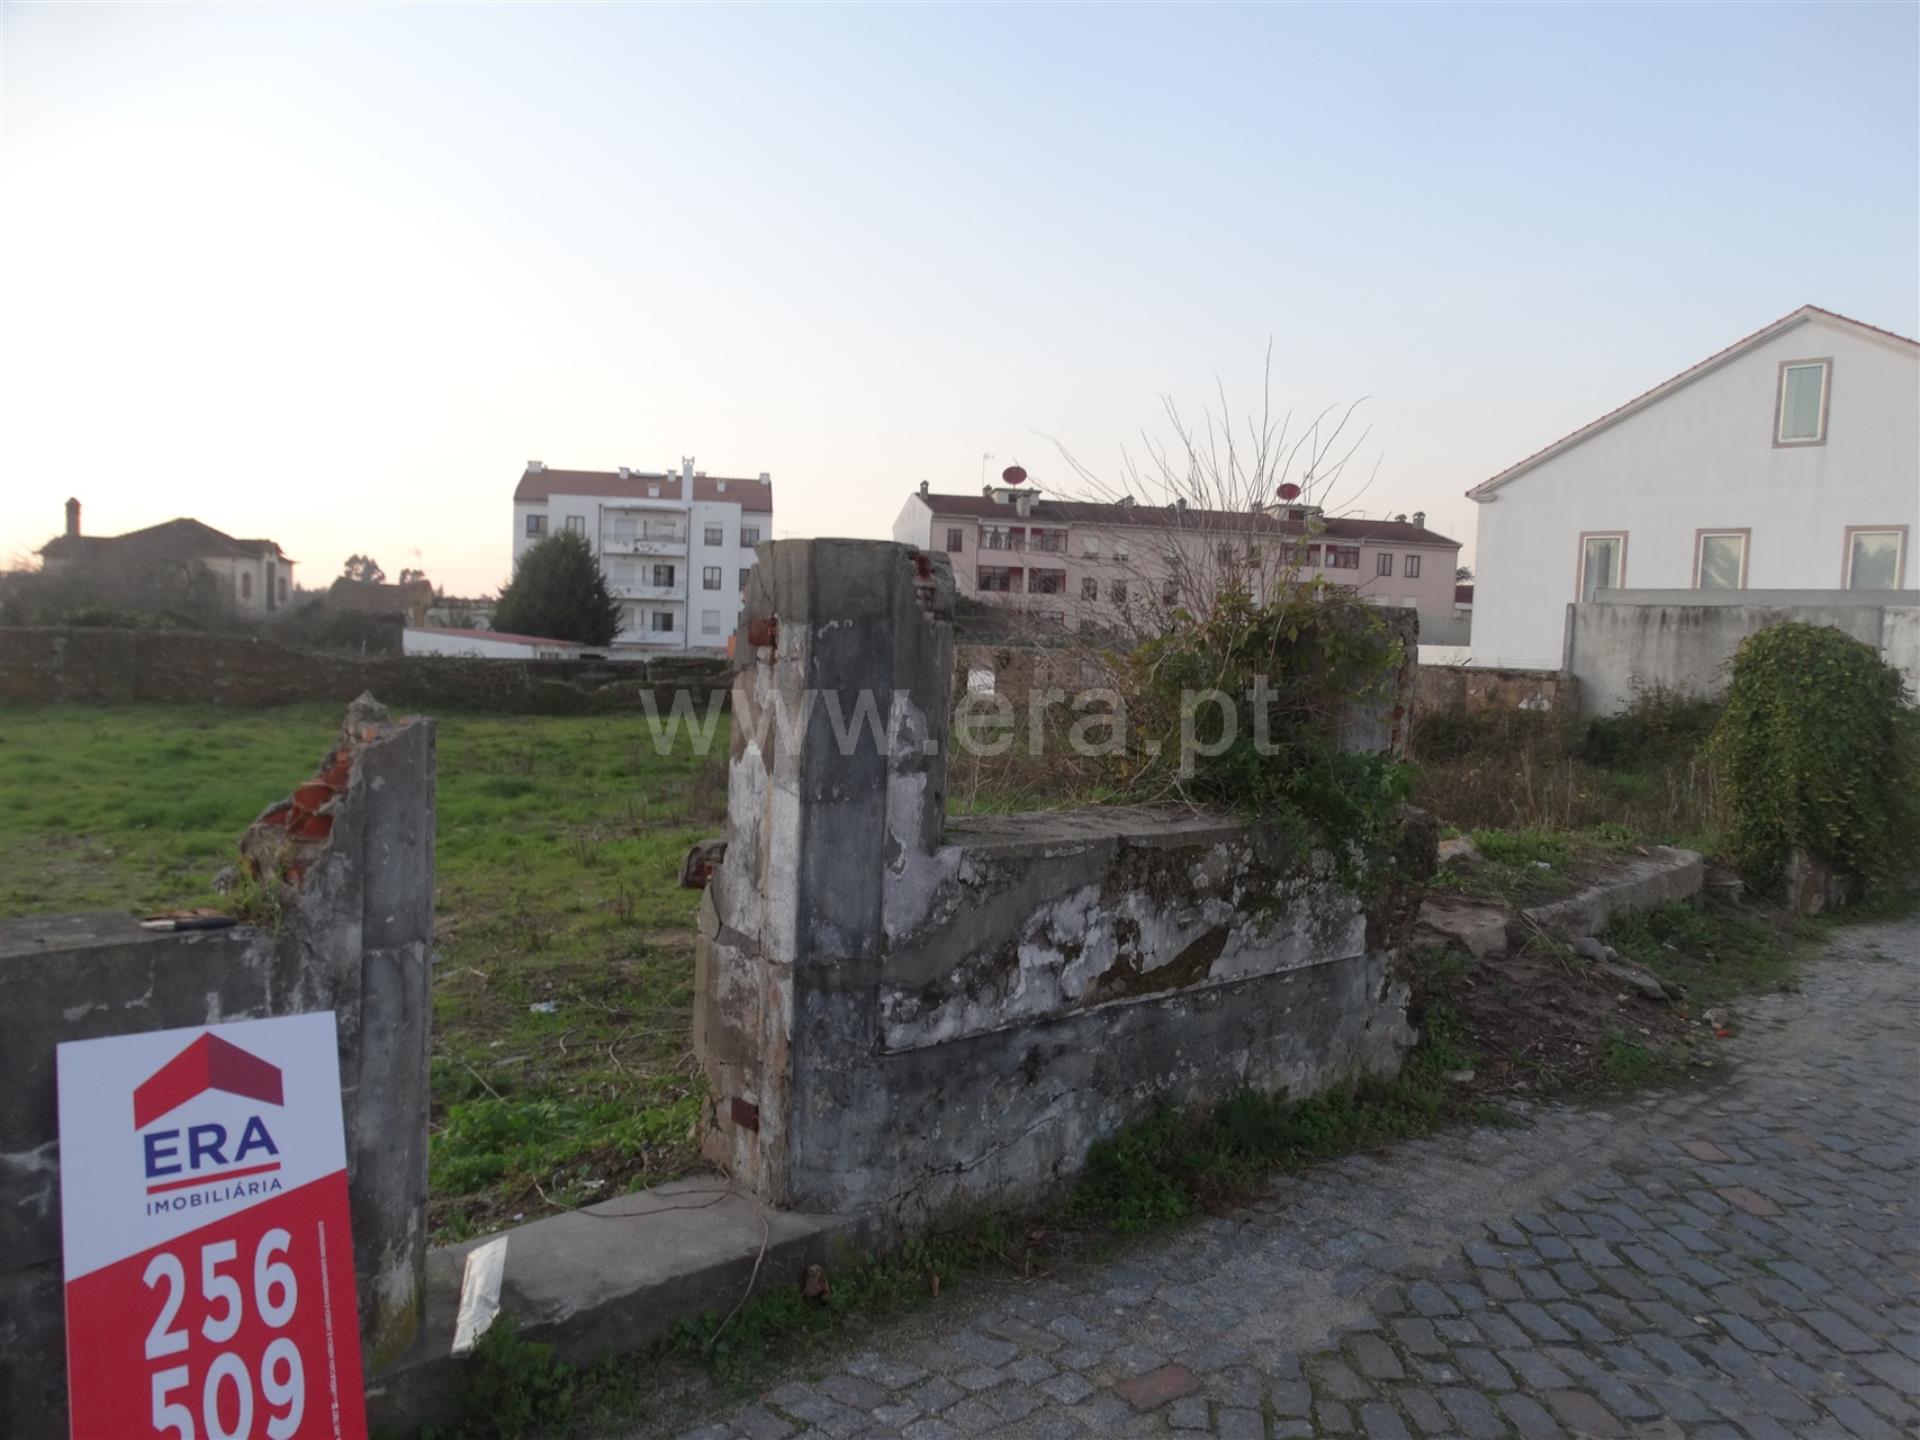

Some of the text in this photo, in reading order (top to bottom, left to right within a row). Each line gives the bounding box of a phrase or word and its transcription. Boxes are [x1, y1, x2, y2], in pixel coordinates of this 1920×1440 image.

[143, 1115, 280, 1178] ERA
[146, 1178, 283, 1216] IMOBILIÁRIA
[142, 1228, 298, 1360] 256
[151, 1337, 305, 1440] 509
